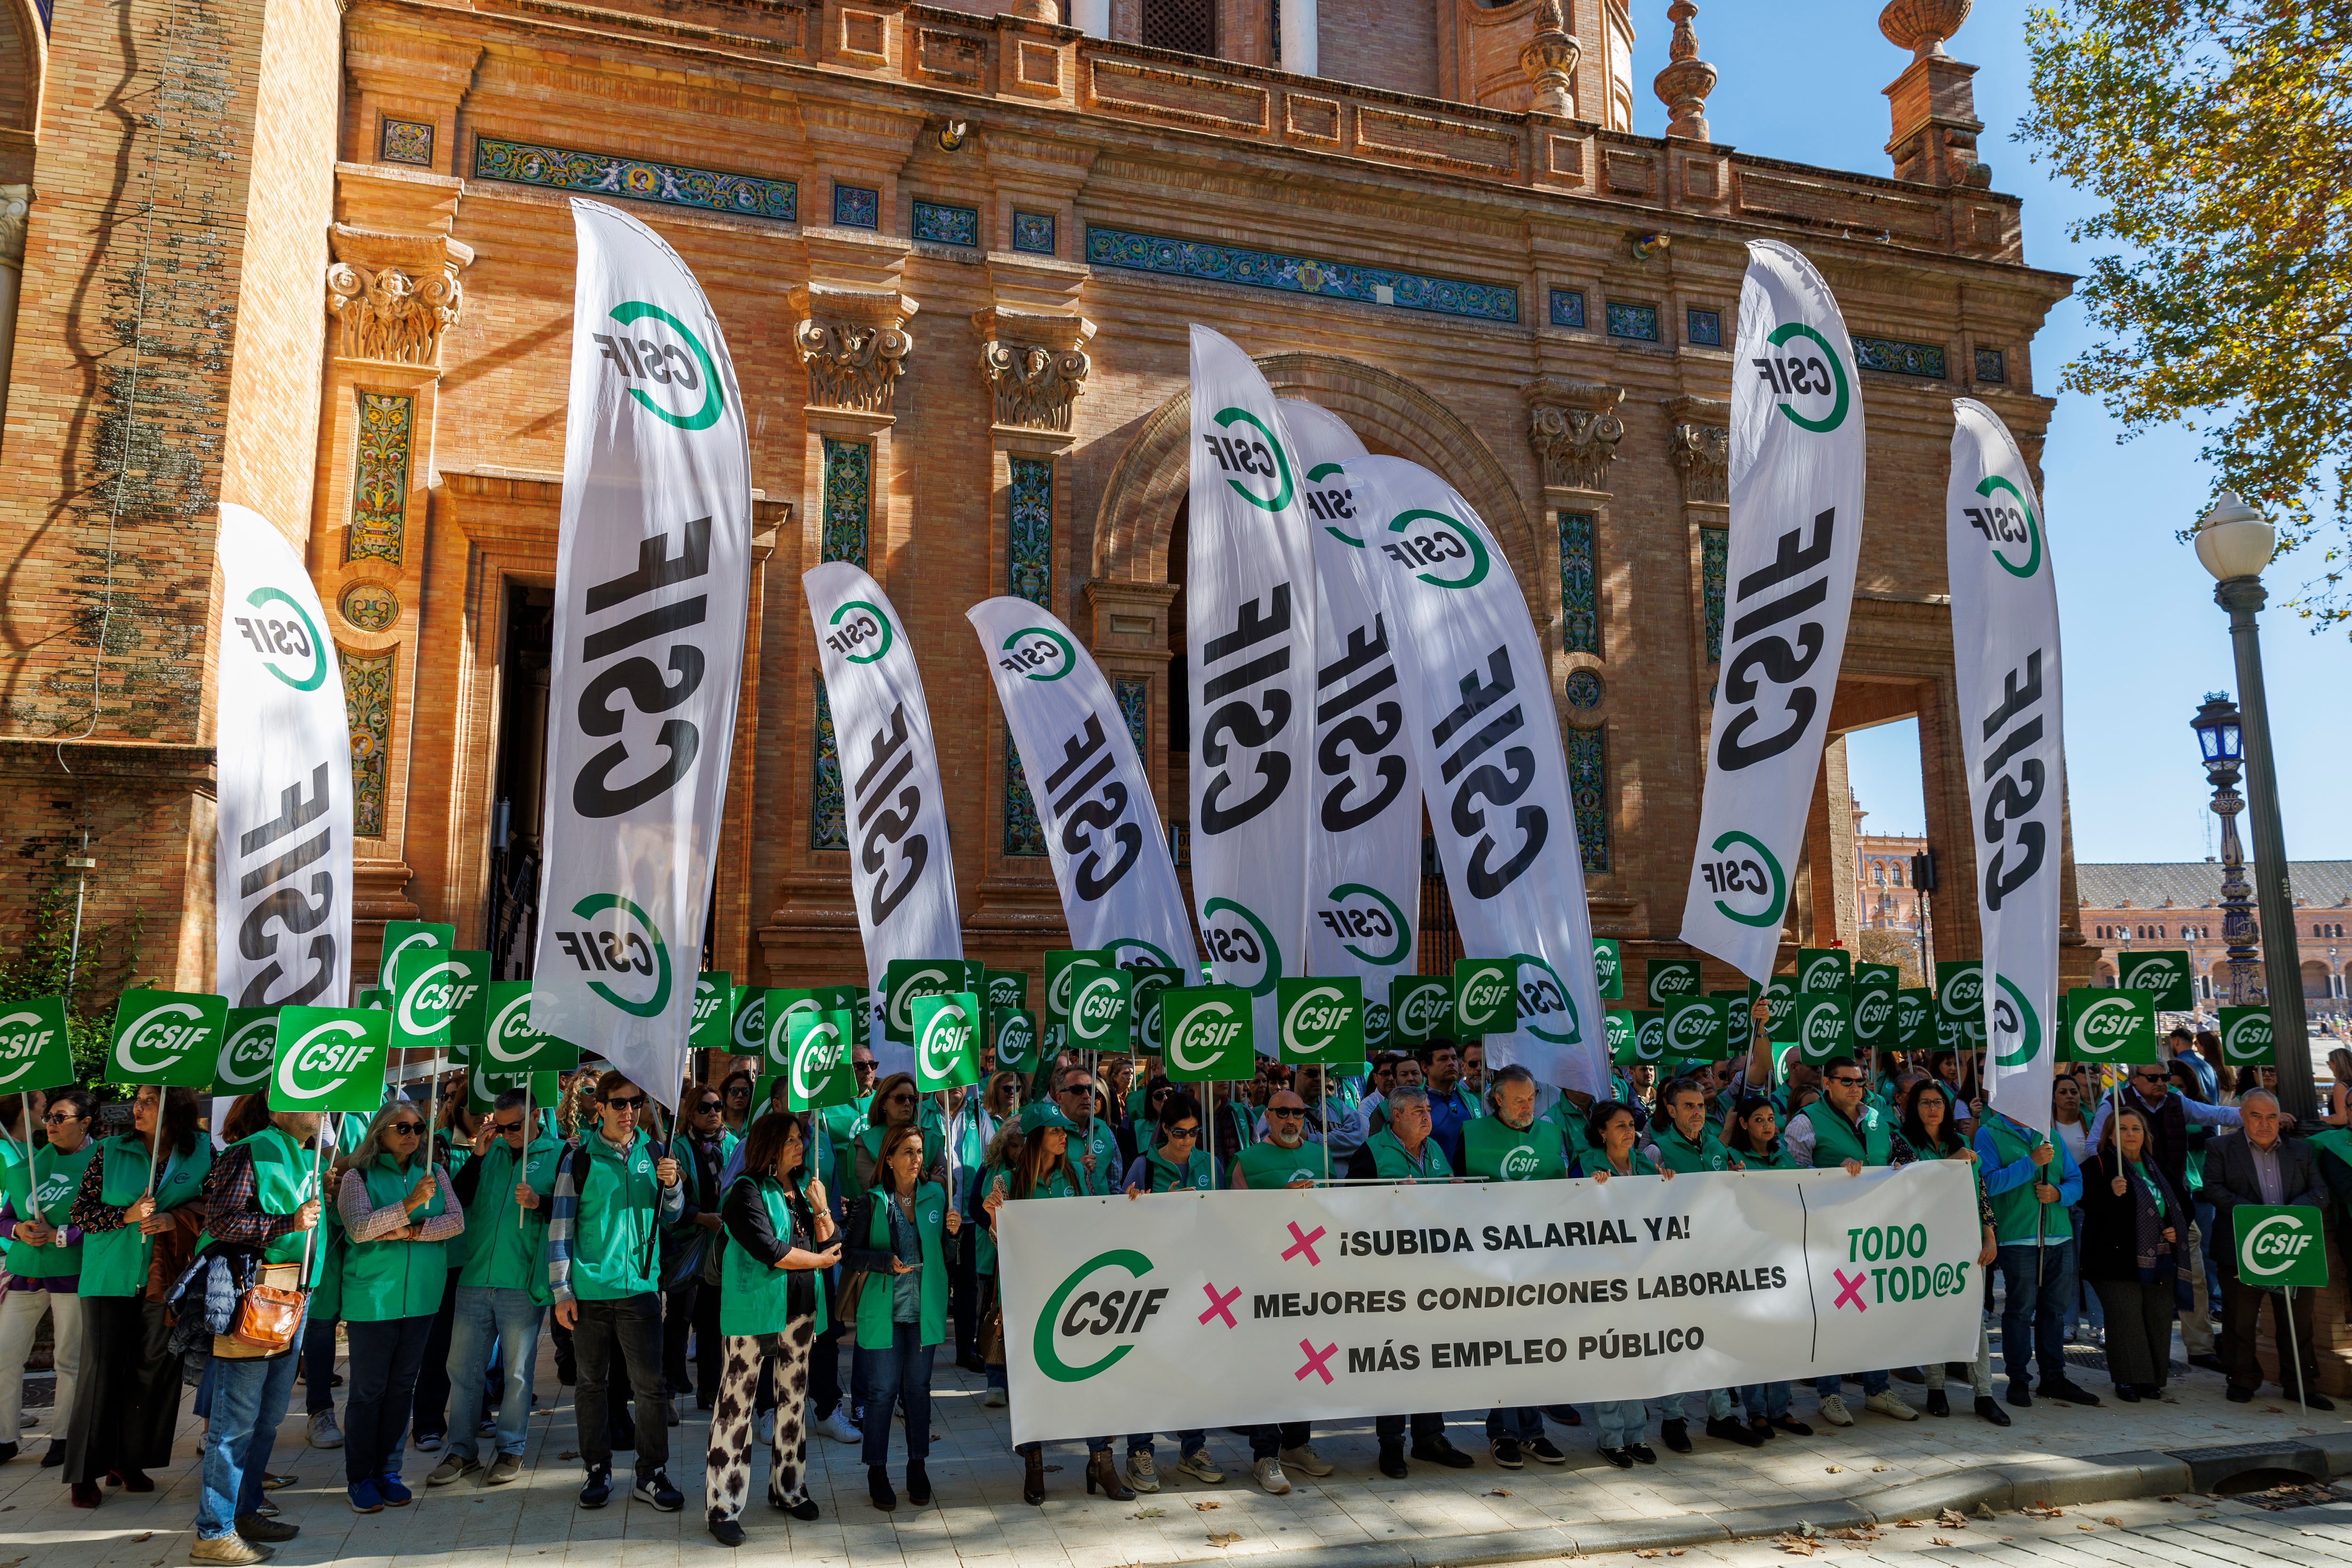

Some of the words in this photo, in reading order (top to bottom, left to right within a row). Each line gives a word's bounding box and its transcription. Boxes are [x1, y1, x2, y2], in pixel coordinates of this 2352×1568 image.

[1659, 978, 1694, 990] CSIF
[1810, 972, 1845, 988] CSIF
[2136, 972, 2181, 988] CSIF
[416, 986, 479, 1009] CSIF
[989, 990, 1020, 1003] CSIF
[1469, 985, 1510, 1006] CSIF
[1952, 982, 1983, 999] CSI
[691, 998, 722, 1018] SIF
[1084, 995, 1125, 1019] CSIF
[1408, 1000, 1454, 1018] CSIF
[1767, 999, 1795, 1017] SIF
[1862, 1005, 1893, 1022] CSIF
[1297, 1007, 1353, 1031] CSIF
[1678, 1018, 1721, 1036] CSIF
[1899, 1010, 1926, 1027] SIF
[2088, 1015, 2144, 1035] CSIF
[136, 1023, 211, 1050] CSIF
[931, 1026, 972, 1053] CSIF
[1005, 1030, 1033, 1048] CSIF
[1184, 1023, 1242, 1047] CSIF
[1607, 1029, 1629, 1044] SIF
[1811, 1021, 1845, 1039] CSIF
[299, 1046, 375, 1072] CSIF
[804, 1044, 845, 1072] CSIF
[1509, 1158, 1540, 1172] CSIF
[1341, 1228, 1474, 1257] ¡SUBIDA
[1483, 1219, 1637, 1251] SALARIAL
[1643, 1216, 1690, 1242] YA!
[1848, 1223, 1927, 1263] TODO
[2257, 1234, 2313, 1255] CSIF
[1254, 1290, 1406, 1319] MEJORES
[1417, 1279, 1628, 1311] CONDICIONES
[1637, 1266, 1787, 1300] LABORALES
[1871, 1262, 1970, 1304] TOD@S
[1061, 1288, 1169, 1337] CSIF
[1349, 1339, 1420, 1373] MÁS
[1432, 1338, 1566, 1369] EMPLEO
[1579, 1327, 1704, 1361] PÚBLICO
